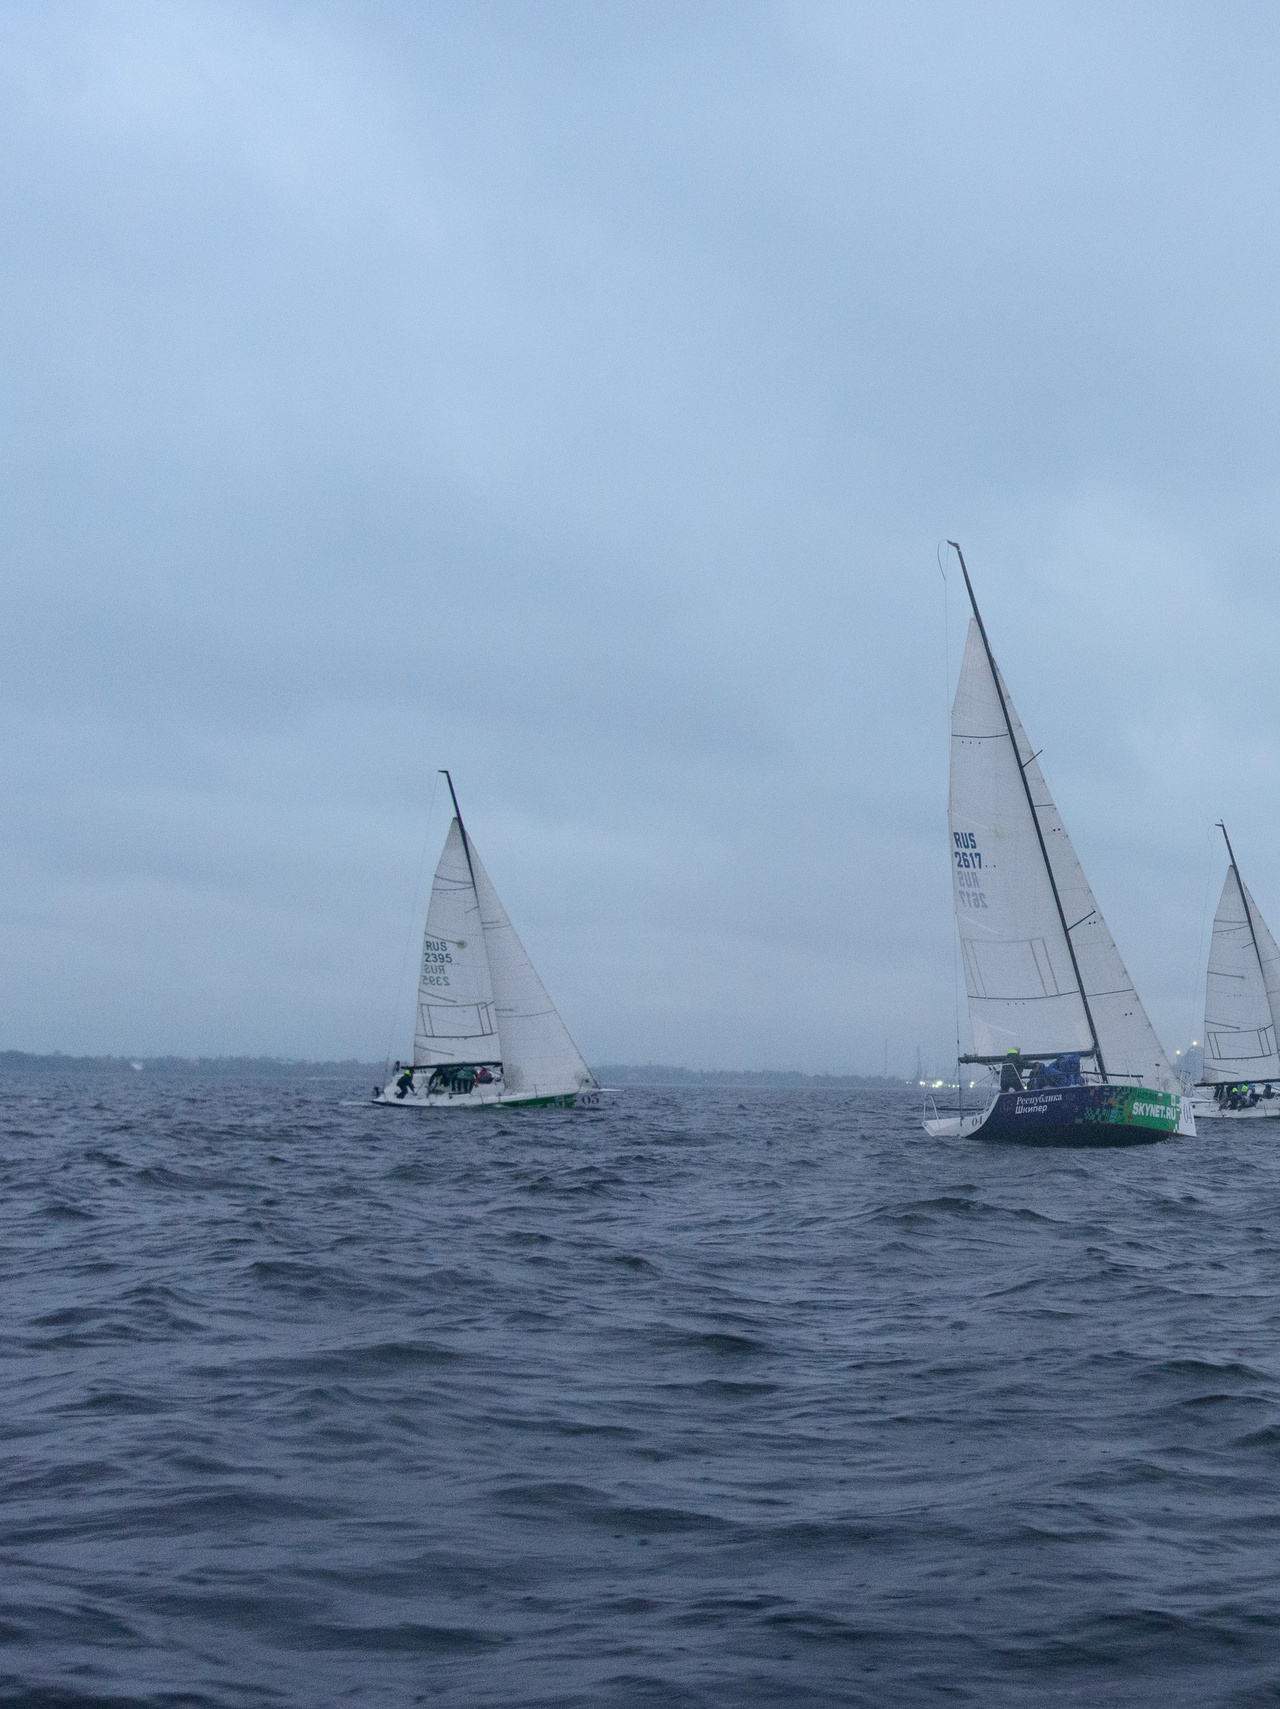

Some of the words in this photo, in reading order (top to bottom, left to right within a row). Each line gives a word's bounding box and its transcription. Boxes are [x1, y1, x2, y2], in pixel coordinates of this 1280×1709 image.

[953, 832, 977, 849] RUS
[954, 851, 982, 869] 2617
[425, 941, 447, 952] RUS
[424, 952, 453, 964] 2395
[1016, 1094, 1063, 1106] Республика
[1014, 1104, 1048, 1114] Шкипер
[1132, 1102, 1177, 1120] SKYNET.RU
